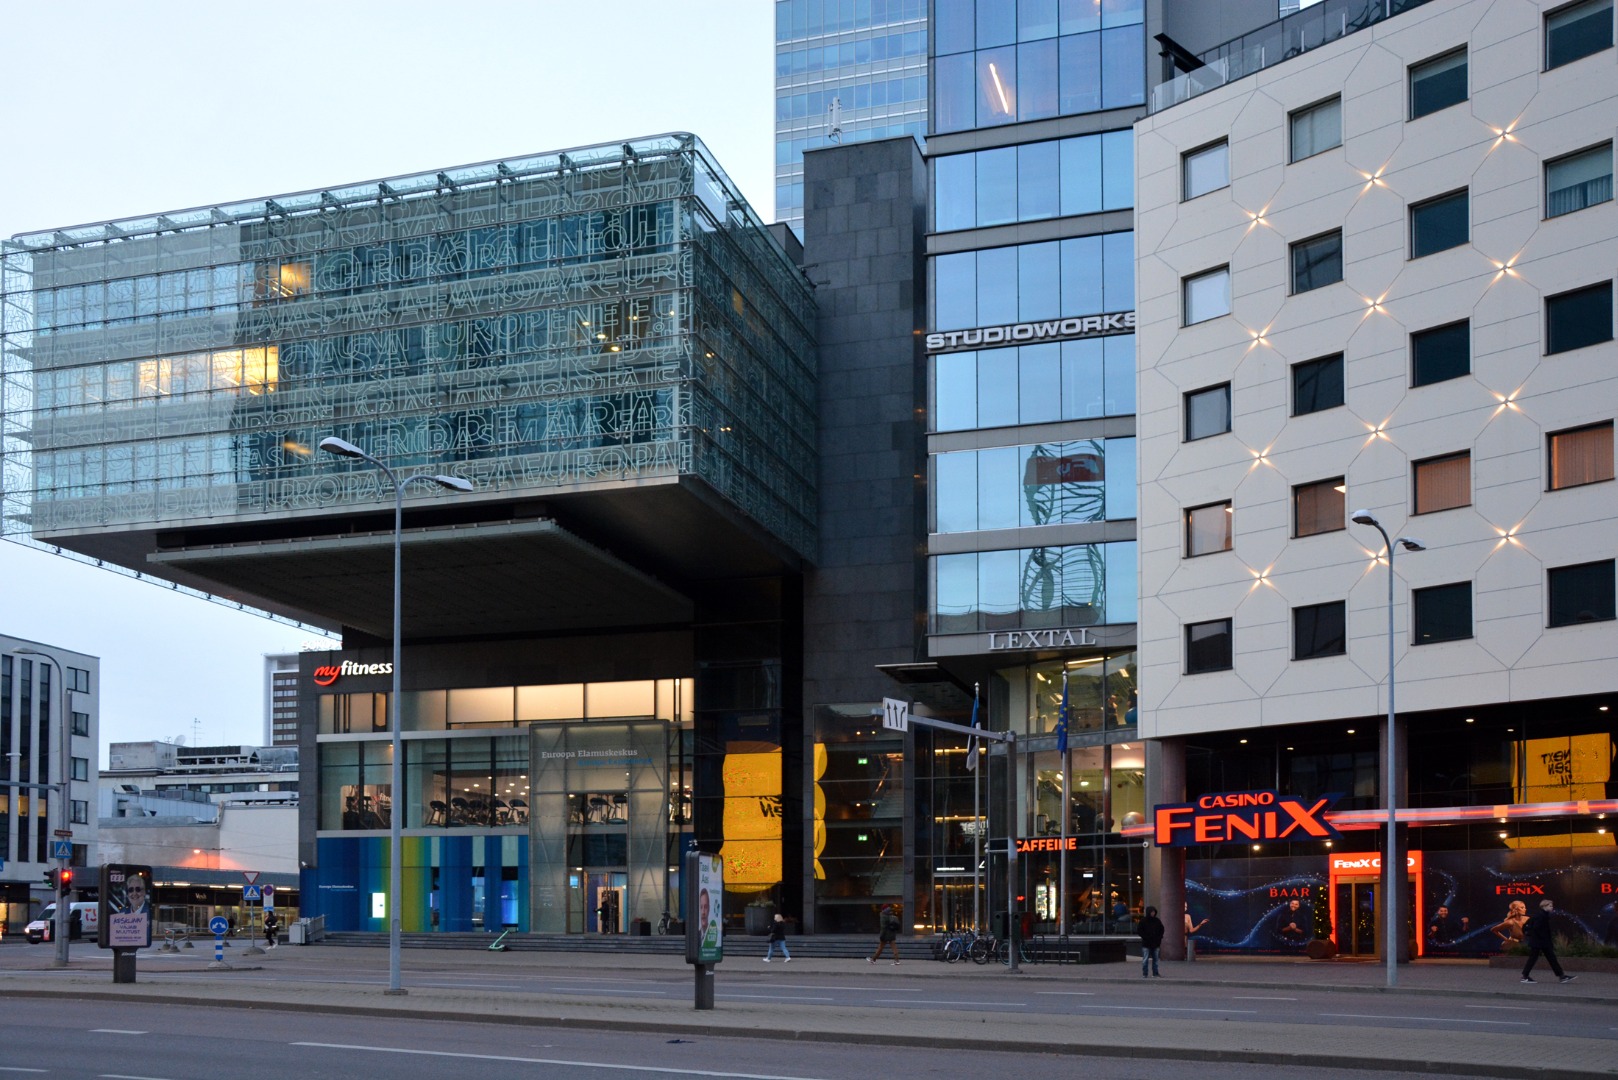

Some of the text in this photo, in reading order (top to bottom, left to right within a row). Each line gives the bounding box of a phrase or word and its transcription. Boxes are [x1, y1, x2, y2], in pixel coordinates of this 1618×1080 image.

[926, 312, 1135, 349] STUDIOWORKS
[988, 628, 1096, 650] LEXTAL
[314, 660, 393, 686] myfitness
[542, 748, 638, 760] Euroopa Elamuskeskus
[1199, 792, 1274, 809] CASINO
[1156, 799, 1330, 844] FENIX
[1334, 859, 1370, 869] FENIX
[1269, 887, 1310, 897] BAAR
[1496, 884, 1545, 895] FENIX
